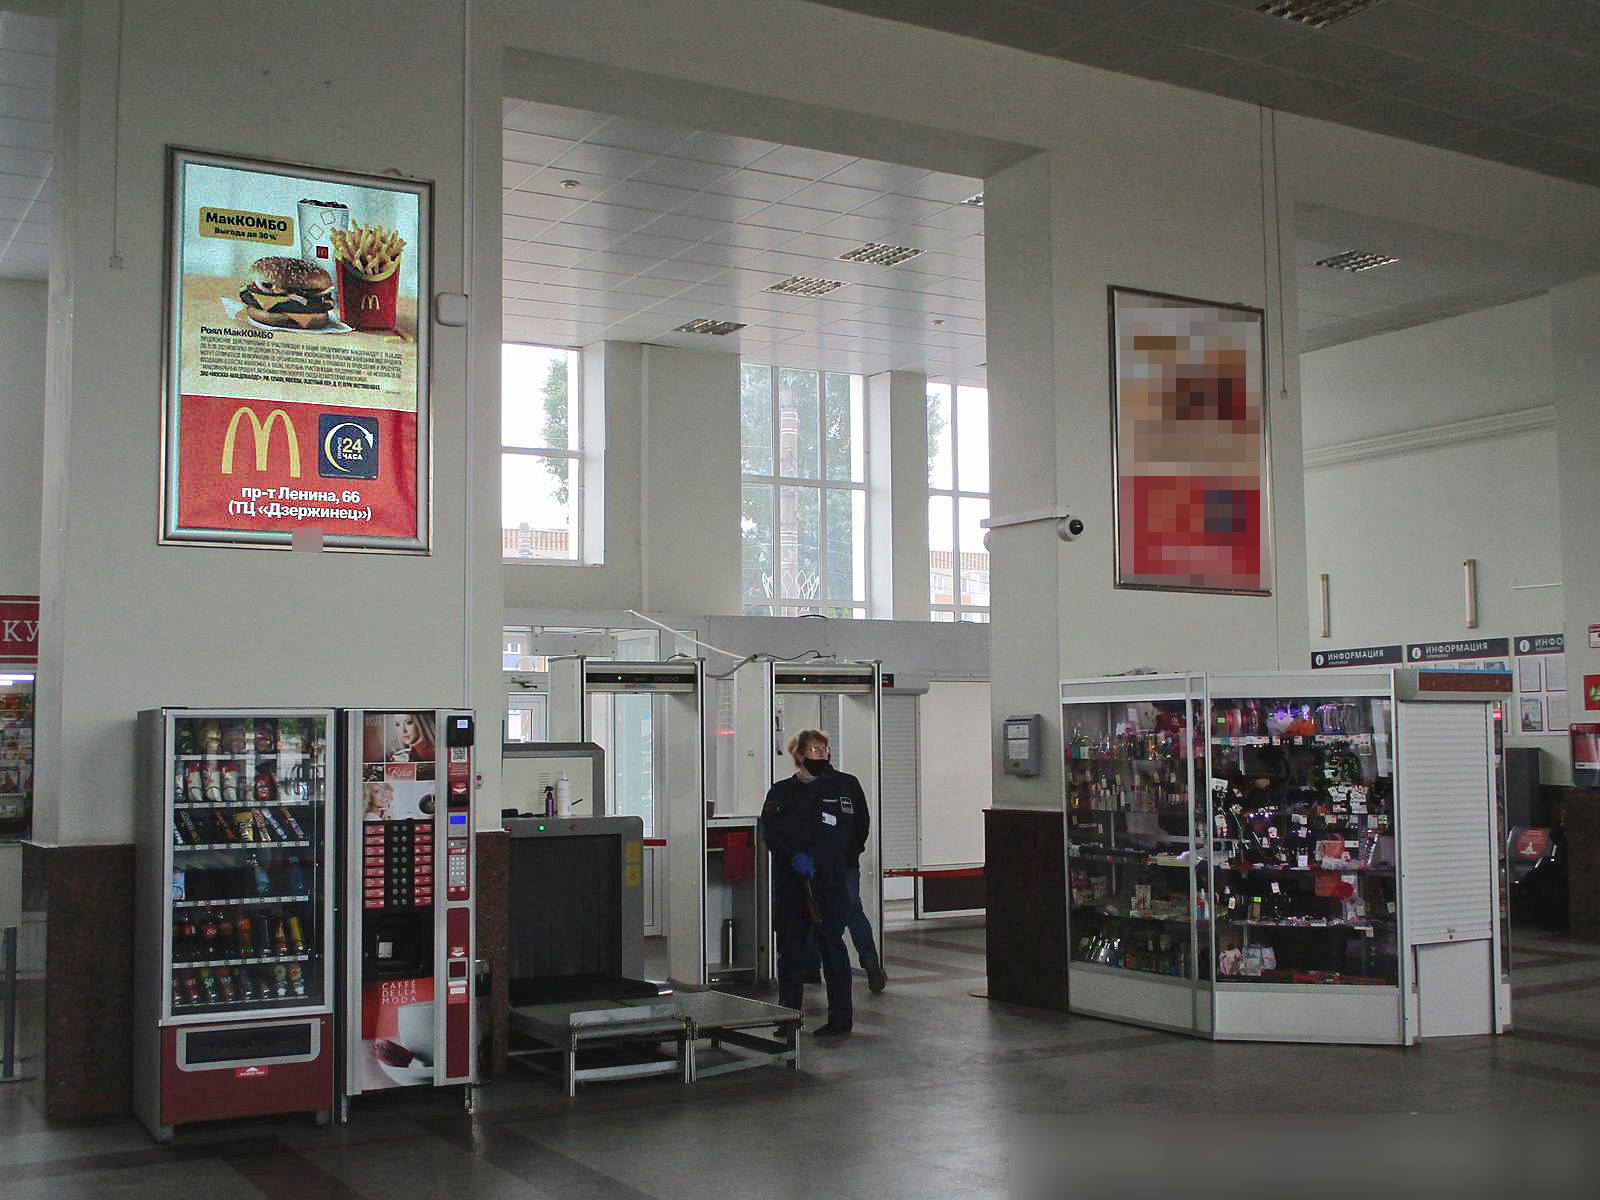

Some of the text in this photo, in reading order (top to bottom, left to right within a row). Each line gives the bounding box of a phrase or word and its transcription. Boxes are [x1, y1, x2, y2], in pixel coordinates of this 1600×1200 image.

[206, 212, 287, 231] МакКОМБО
[200, 326, 273, 339] Роял МакКОМБО
[342, 437, 363, 453] 24
[342, 452, 363, 460] ЧАСА
[241, 486, 361, 504] пр-т Ленина, 66
[228, 500, 372, 521] (ТЦ «Дзержинец»)
[1425, 642, 1488, 654] ИНФОРМАЦИЯ
[1535, 637, 1563, 647] ИНФО
[1327, 649, 1384, 661] ИНФОРМАЦИЯ
[382, 988, 416, 998] DELLA
[382, 996, 416, 1005] MODA
